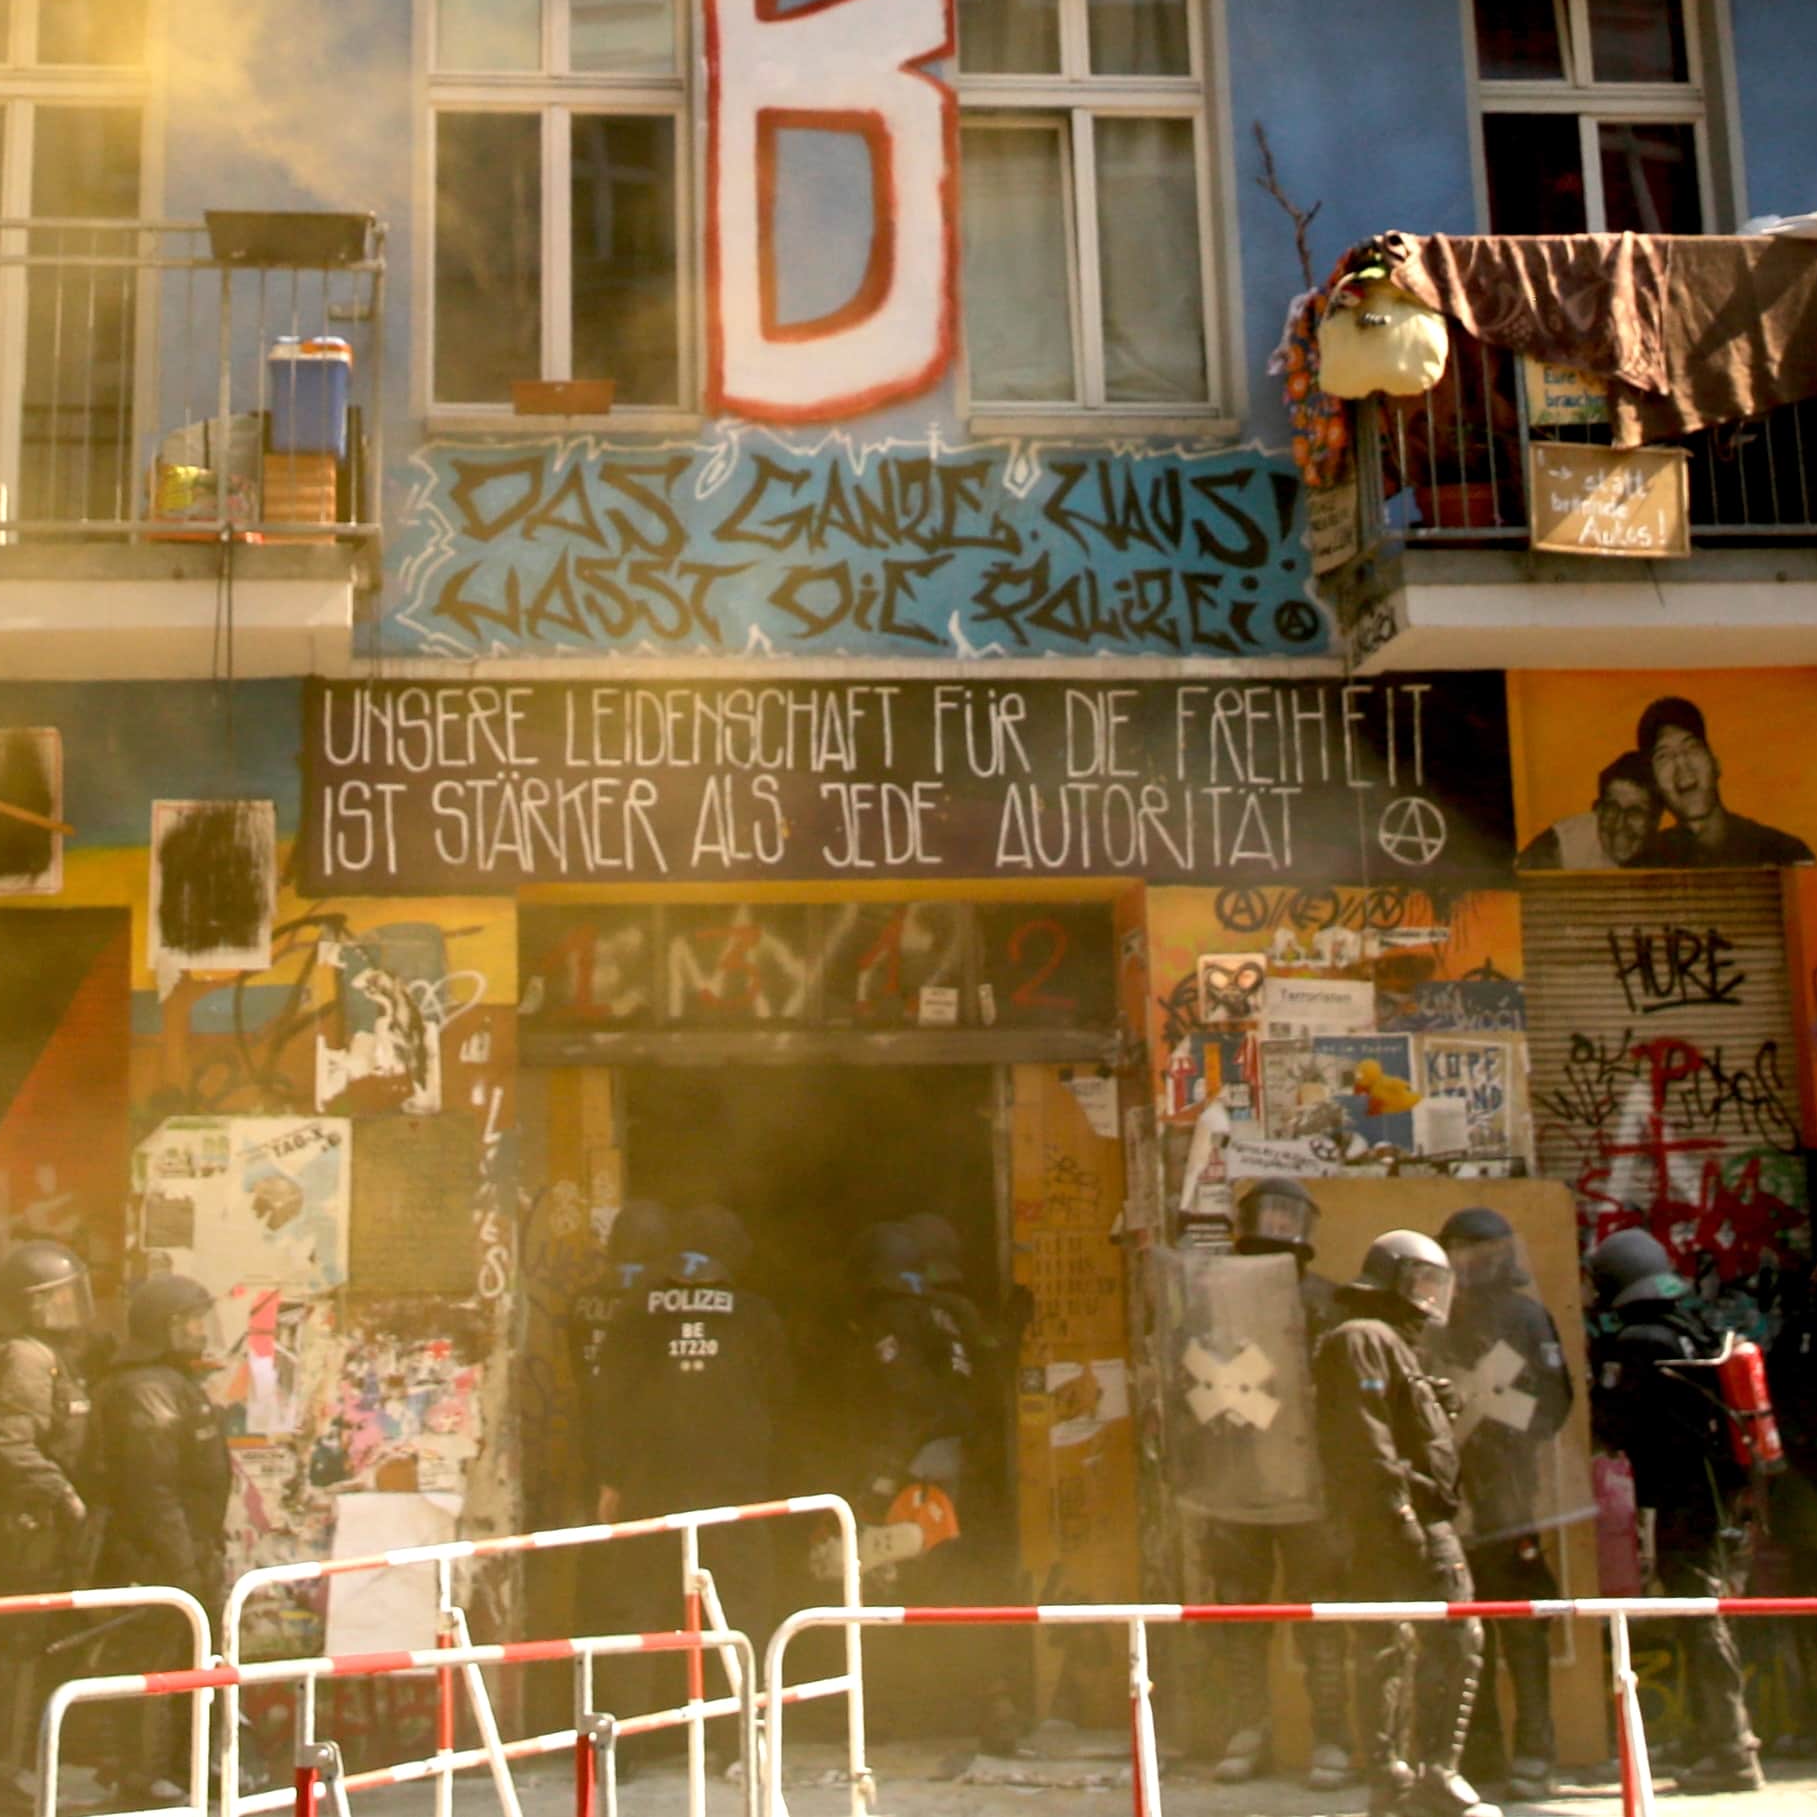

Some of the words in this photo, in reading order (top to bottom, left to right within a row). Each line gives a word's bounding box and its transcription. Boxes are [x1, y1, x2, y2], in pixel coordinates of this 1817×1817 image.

[449, 452, 694, 559] DAS
[324, 687, 539, 772] UNSERE
[565, 687, 900, 772] LEIDENSCHAFT
[934, 686, 1031, 778] FÜR
[1065, 688, 1139, 778] DIE
[1176, 685, 1432, 788] FREIHEIT
[324, 781, 407, 875] IST
[430, 770, 668, 874] STÄRKER
[691, 774, 785, 869] ALS
[822, 781, 943, 869] JEDE
[996, 783, 1303, 871] AUTORITÄT
[1607, 926, 1746, 1012] HURE
[648, 1290, 734, 1314] POLIZEI
[682, 1322, 704, 1338] BE
